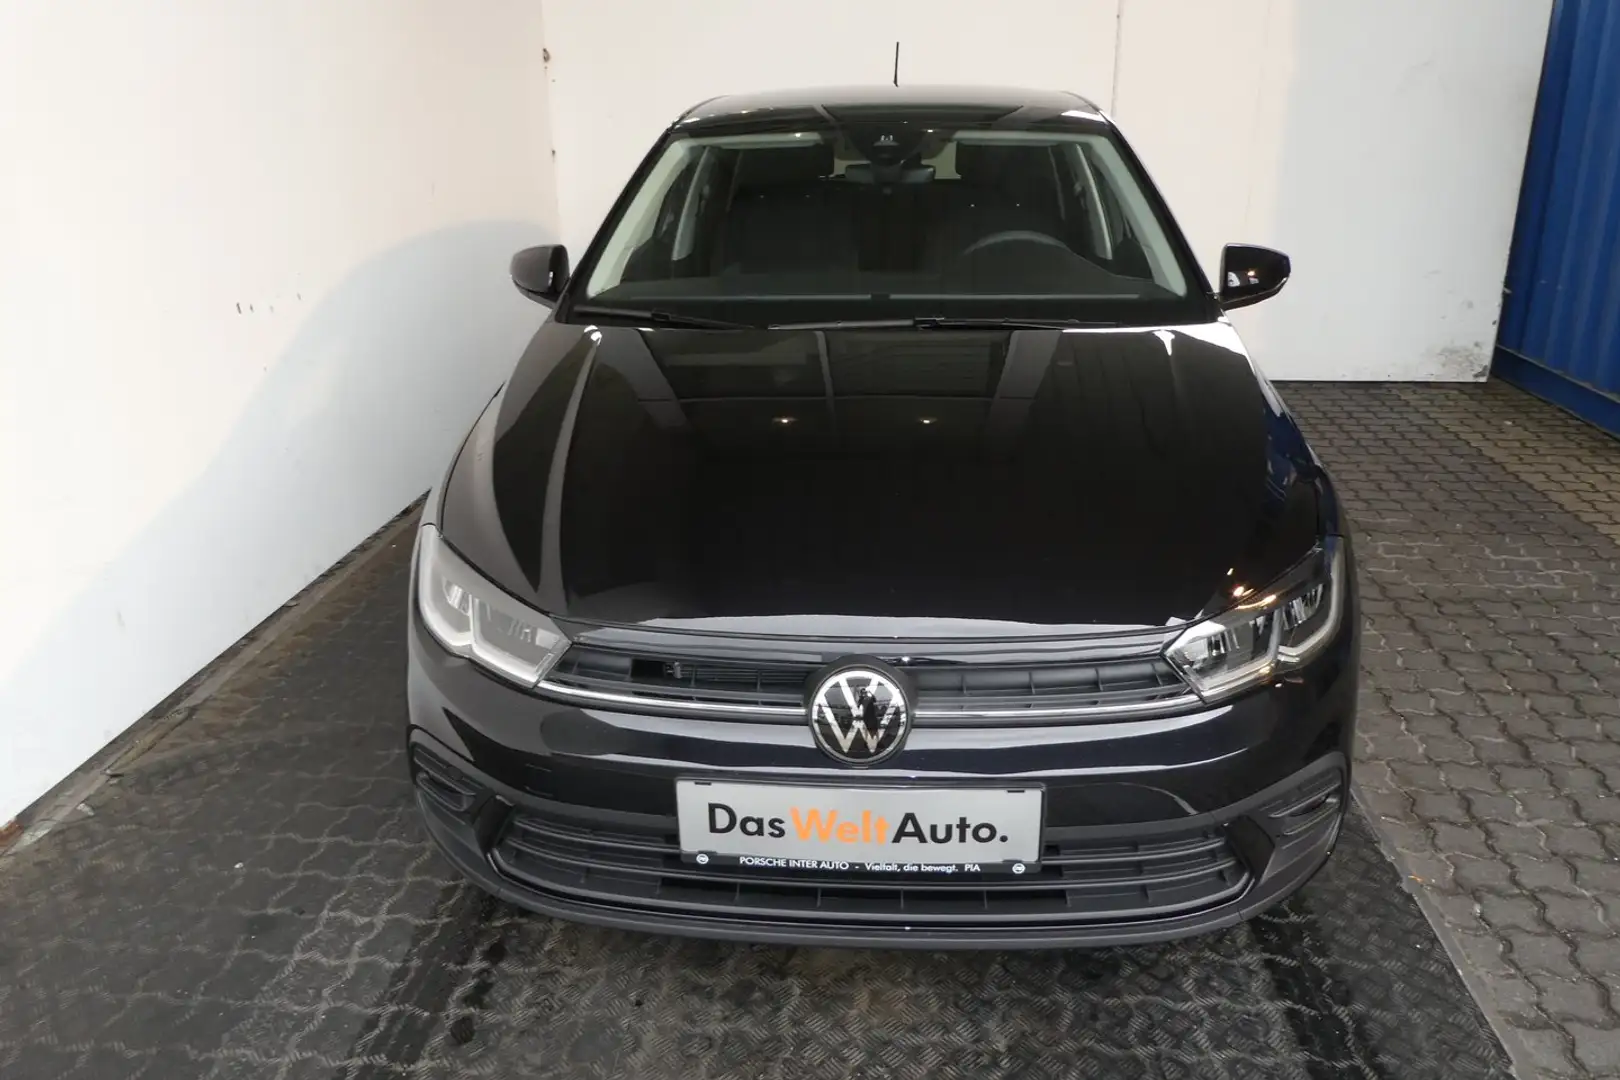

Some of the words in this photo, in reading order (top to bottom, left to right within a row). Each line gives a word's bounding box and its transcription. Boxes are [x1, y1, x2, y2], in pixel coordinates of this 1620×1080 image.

[707, 802, 786, 839] Das
[790, 806, 889, 845] Welt
[892, 812, 1009, 844] Auto.
[739, 856, 787, 867] PORSCHE
[789, 859, 818, 869] INTER
[820, 861, 850, 870] AUTO
[864, 862, 901, 873] Vielfalt,
[903, 863, 919, 872] die
[921, 863, 959, 875] bewegt.
[964, 863, 981, 872] PIA
